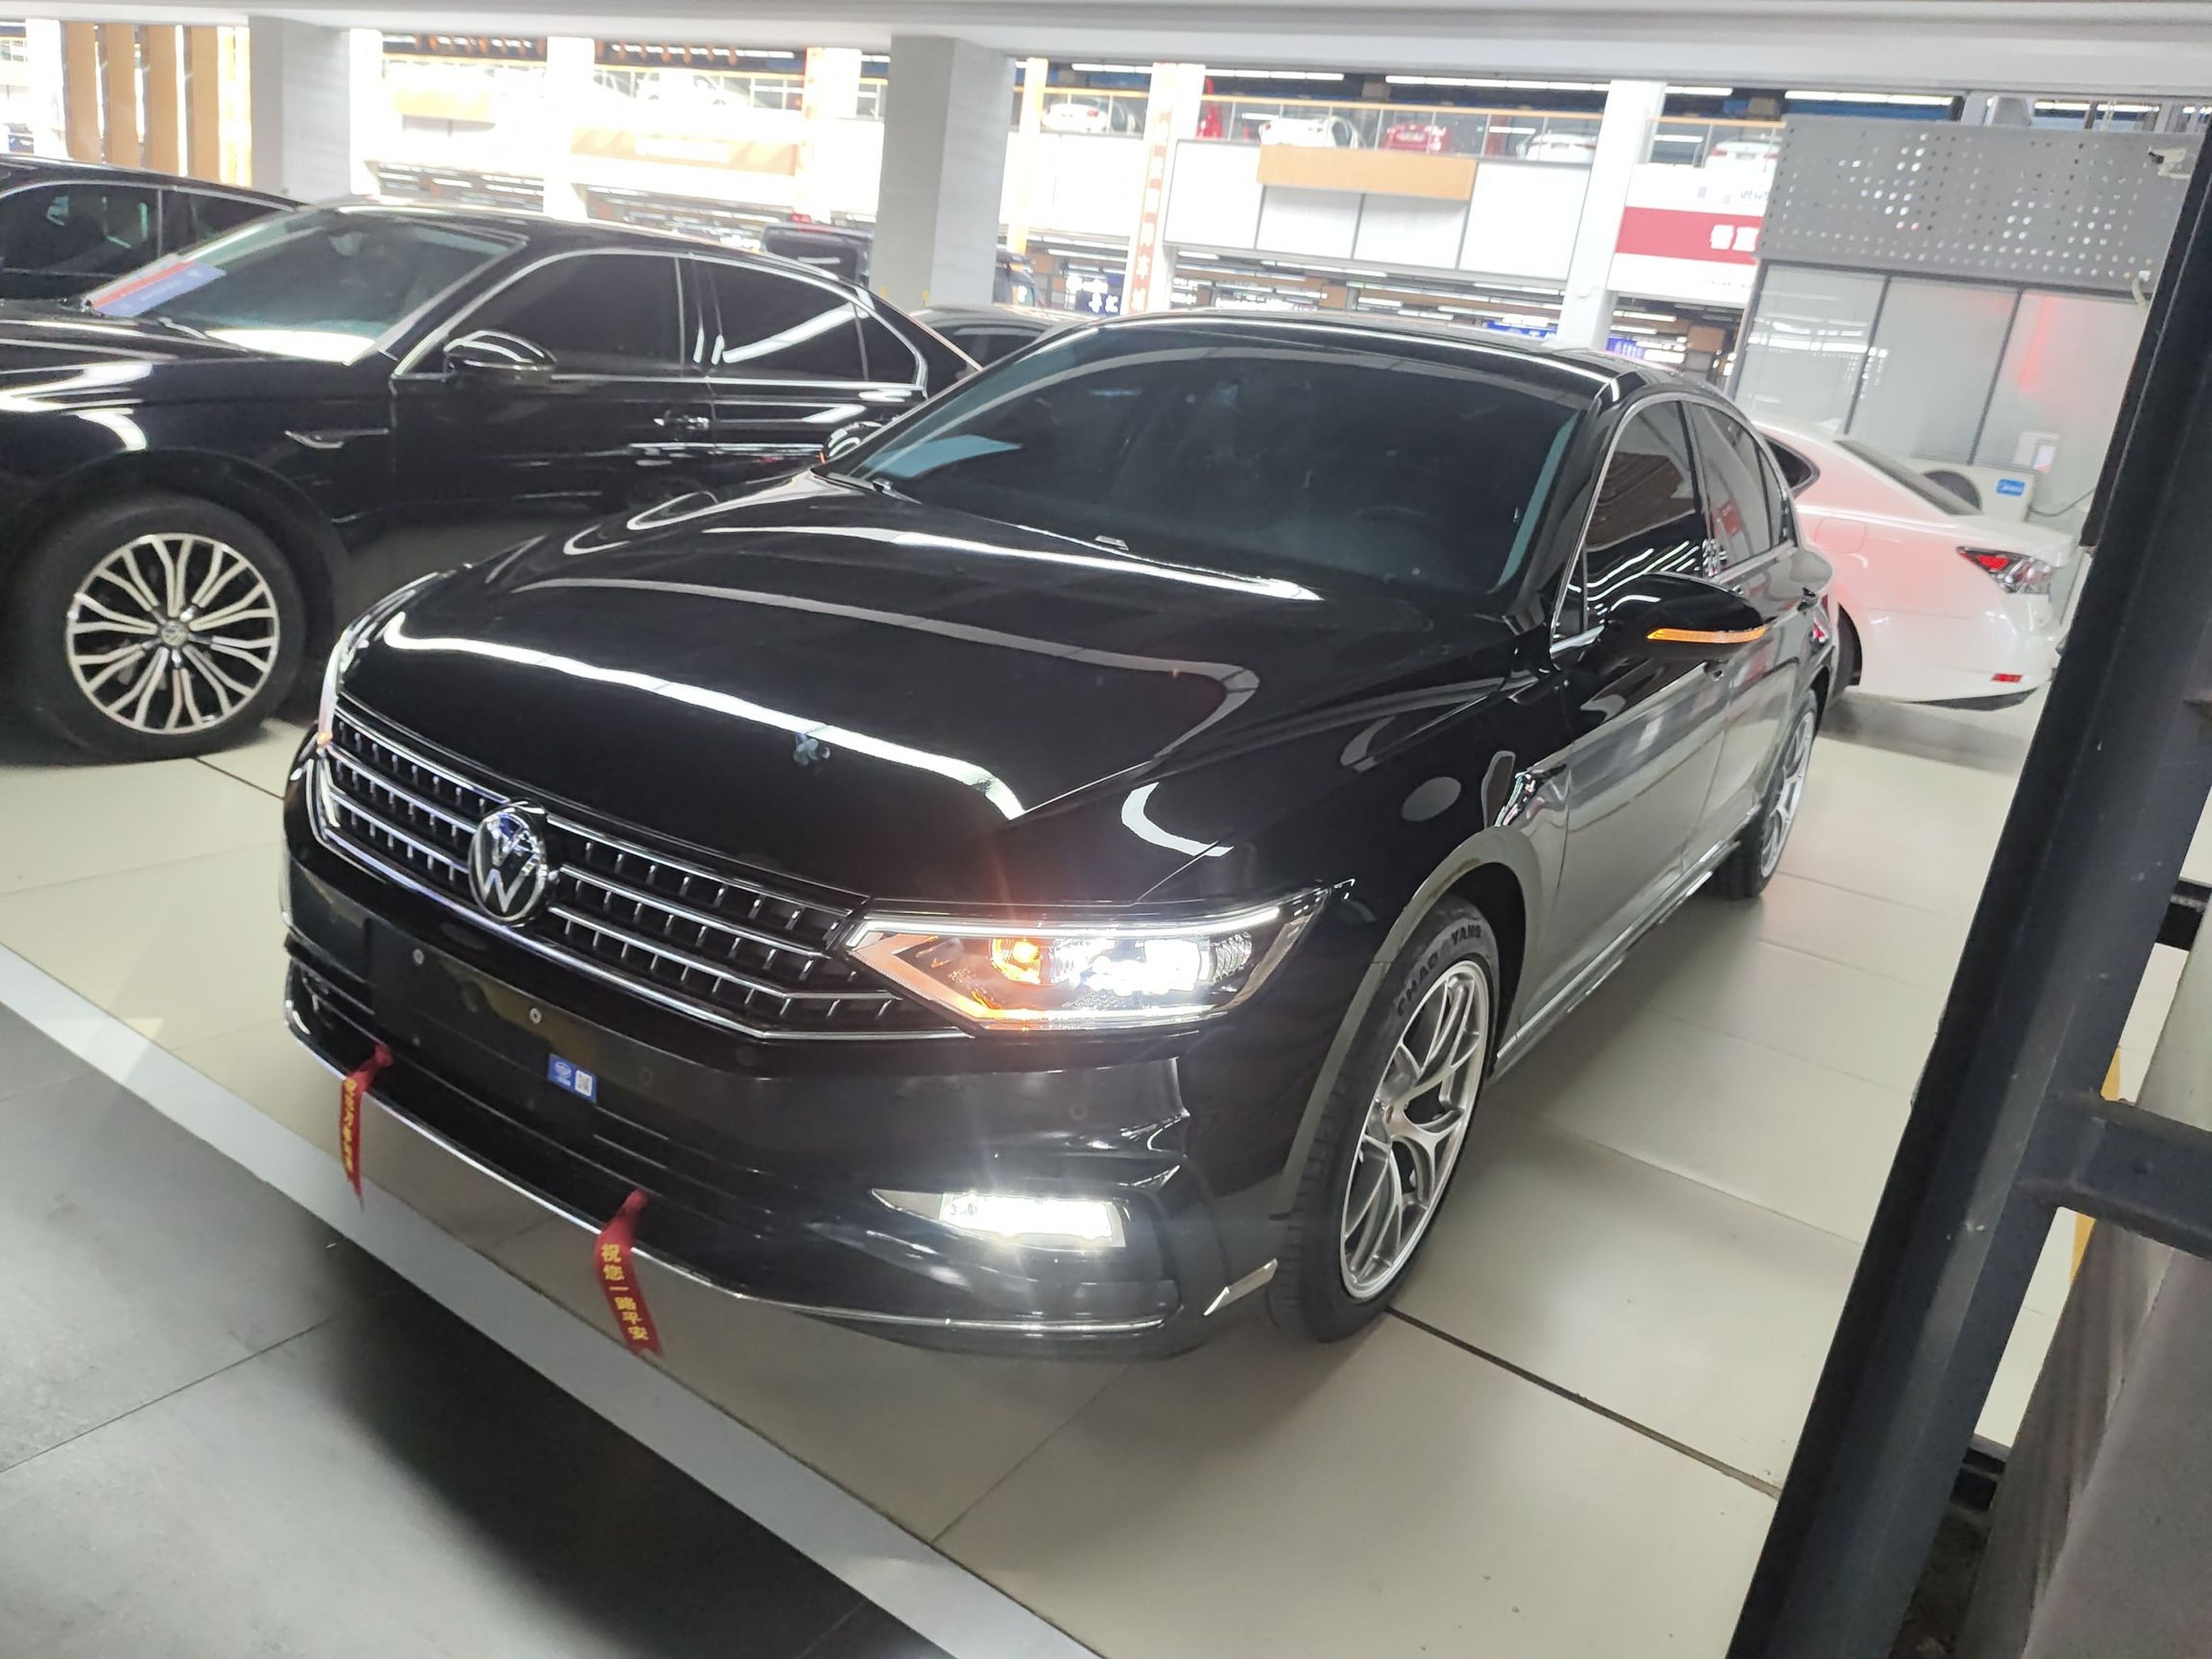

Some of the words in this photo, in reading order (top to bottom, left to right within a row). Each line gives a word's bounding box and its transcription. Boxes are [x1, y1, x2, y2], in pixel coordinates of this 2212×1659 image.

[601, 1244, 649, 1341] 祝您一路平安
